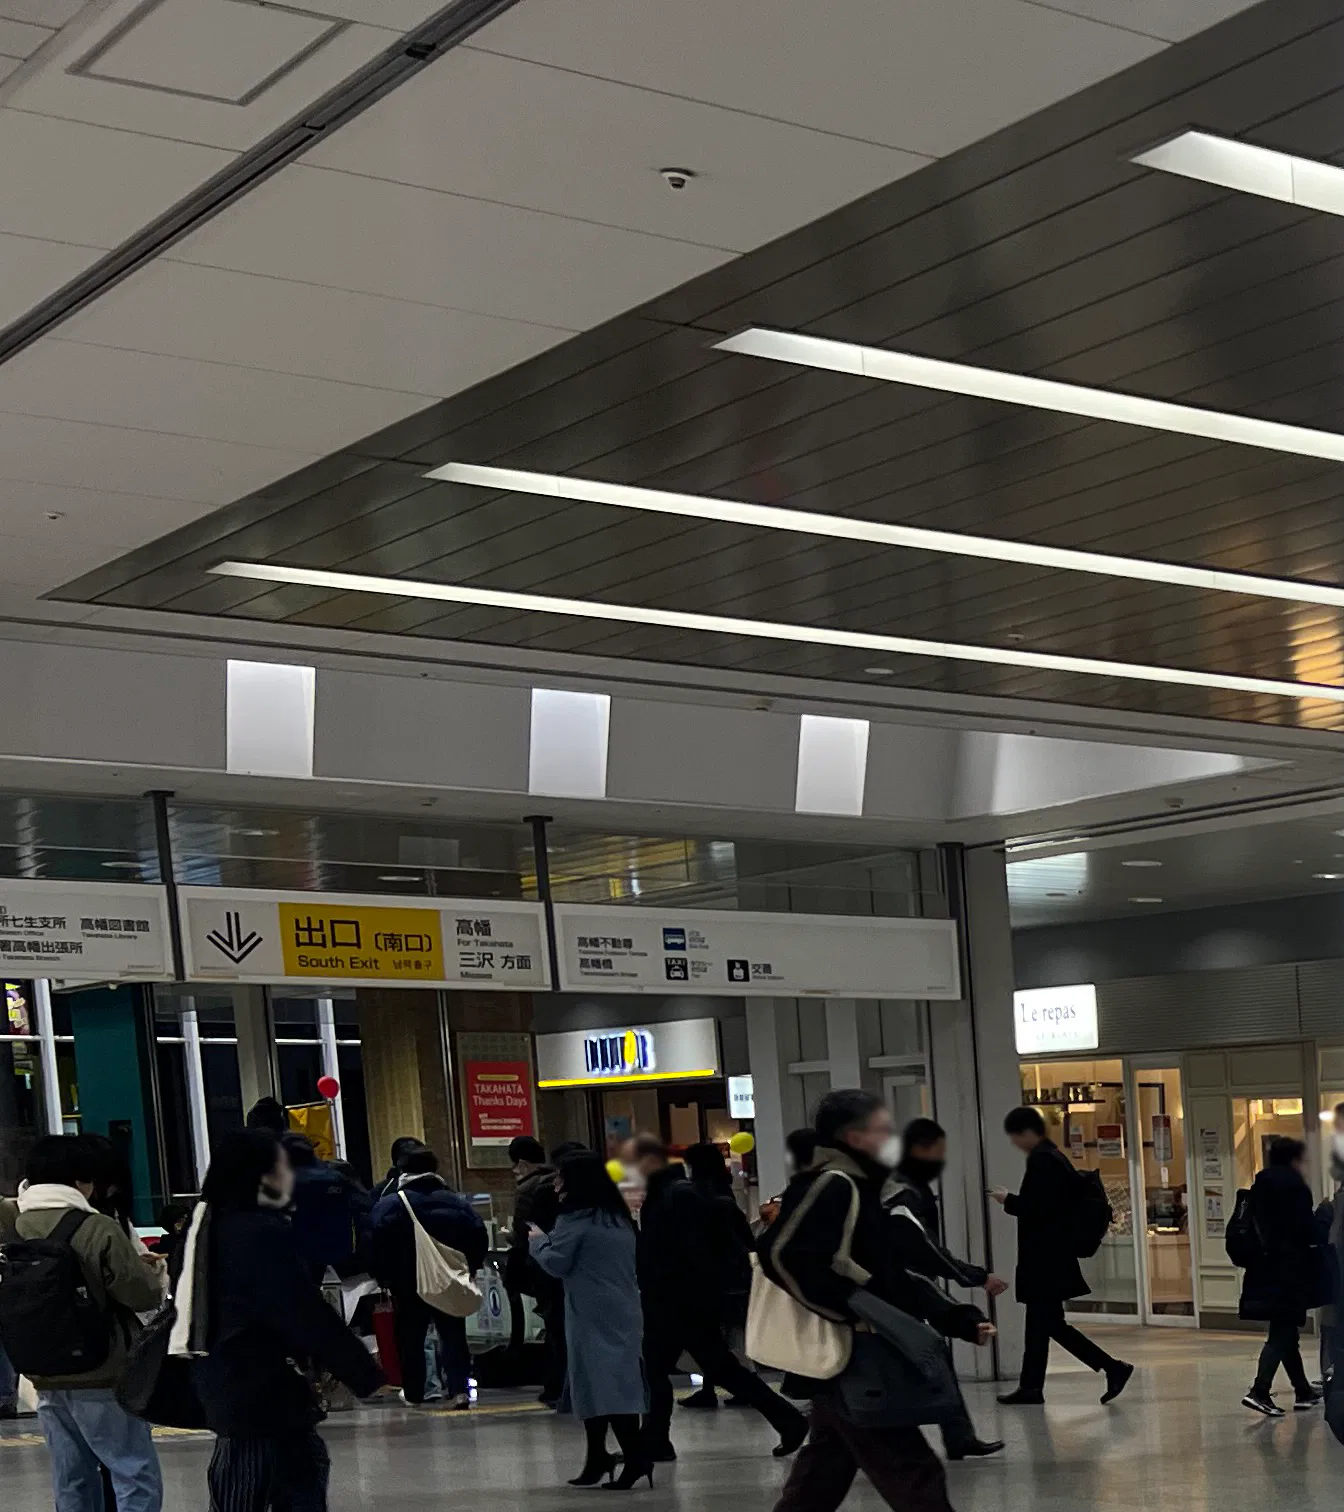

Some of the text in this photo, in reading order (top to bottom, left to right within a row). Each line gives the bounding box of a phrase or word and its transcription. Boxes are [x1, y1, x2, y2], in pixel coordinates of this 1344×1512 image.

[294, 915, 363, 950] 出口
[455, 918, 492, 938] 高幡
[457, 938, 471, 947] For
[298, 954, 381, 971] South Exit
[459, 951, 532, 970] 三沢 方面
[1020, 1003, 1077, 1025] Le repas
[474, 1083, 524, 1095] TAKAHATA
[506, 1095, 527, 1108] Days
